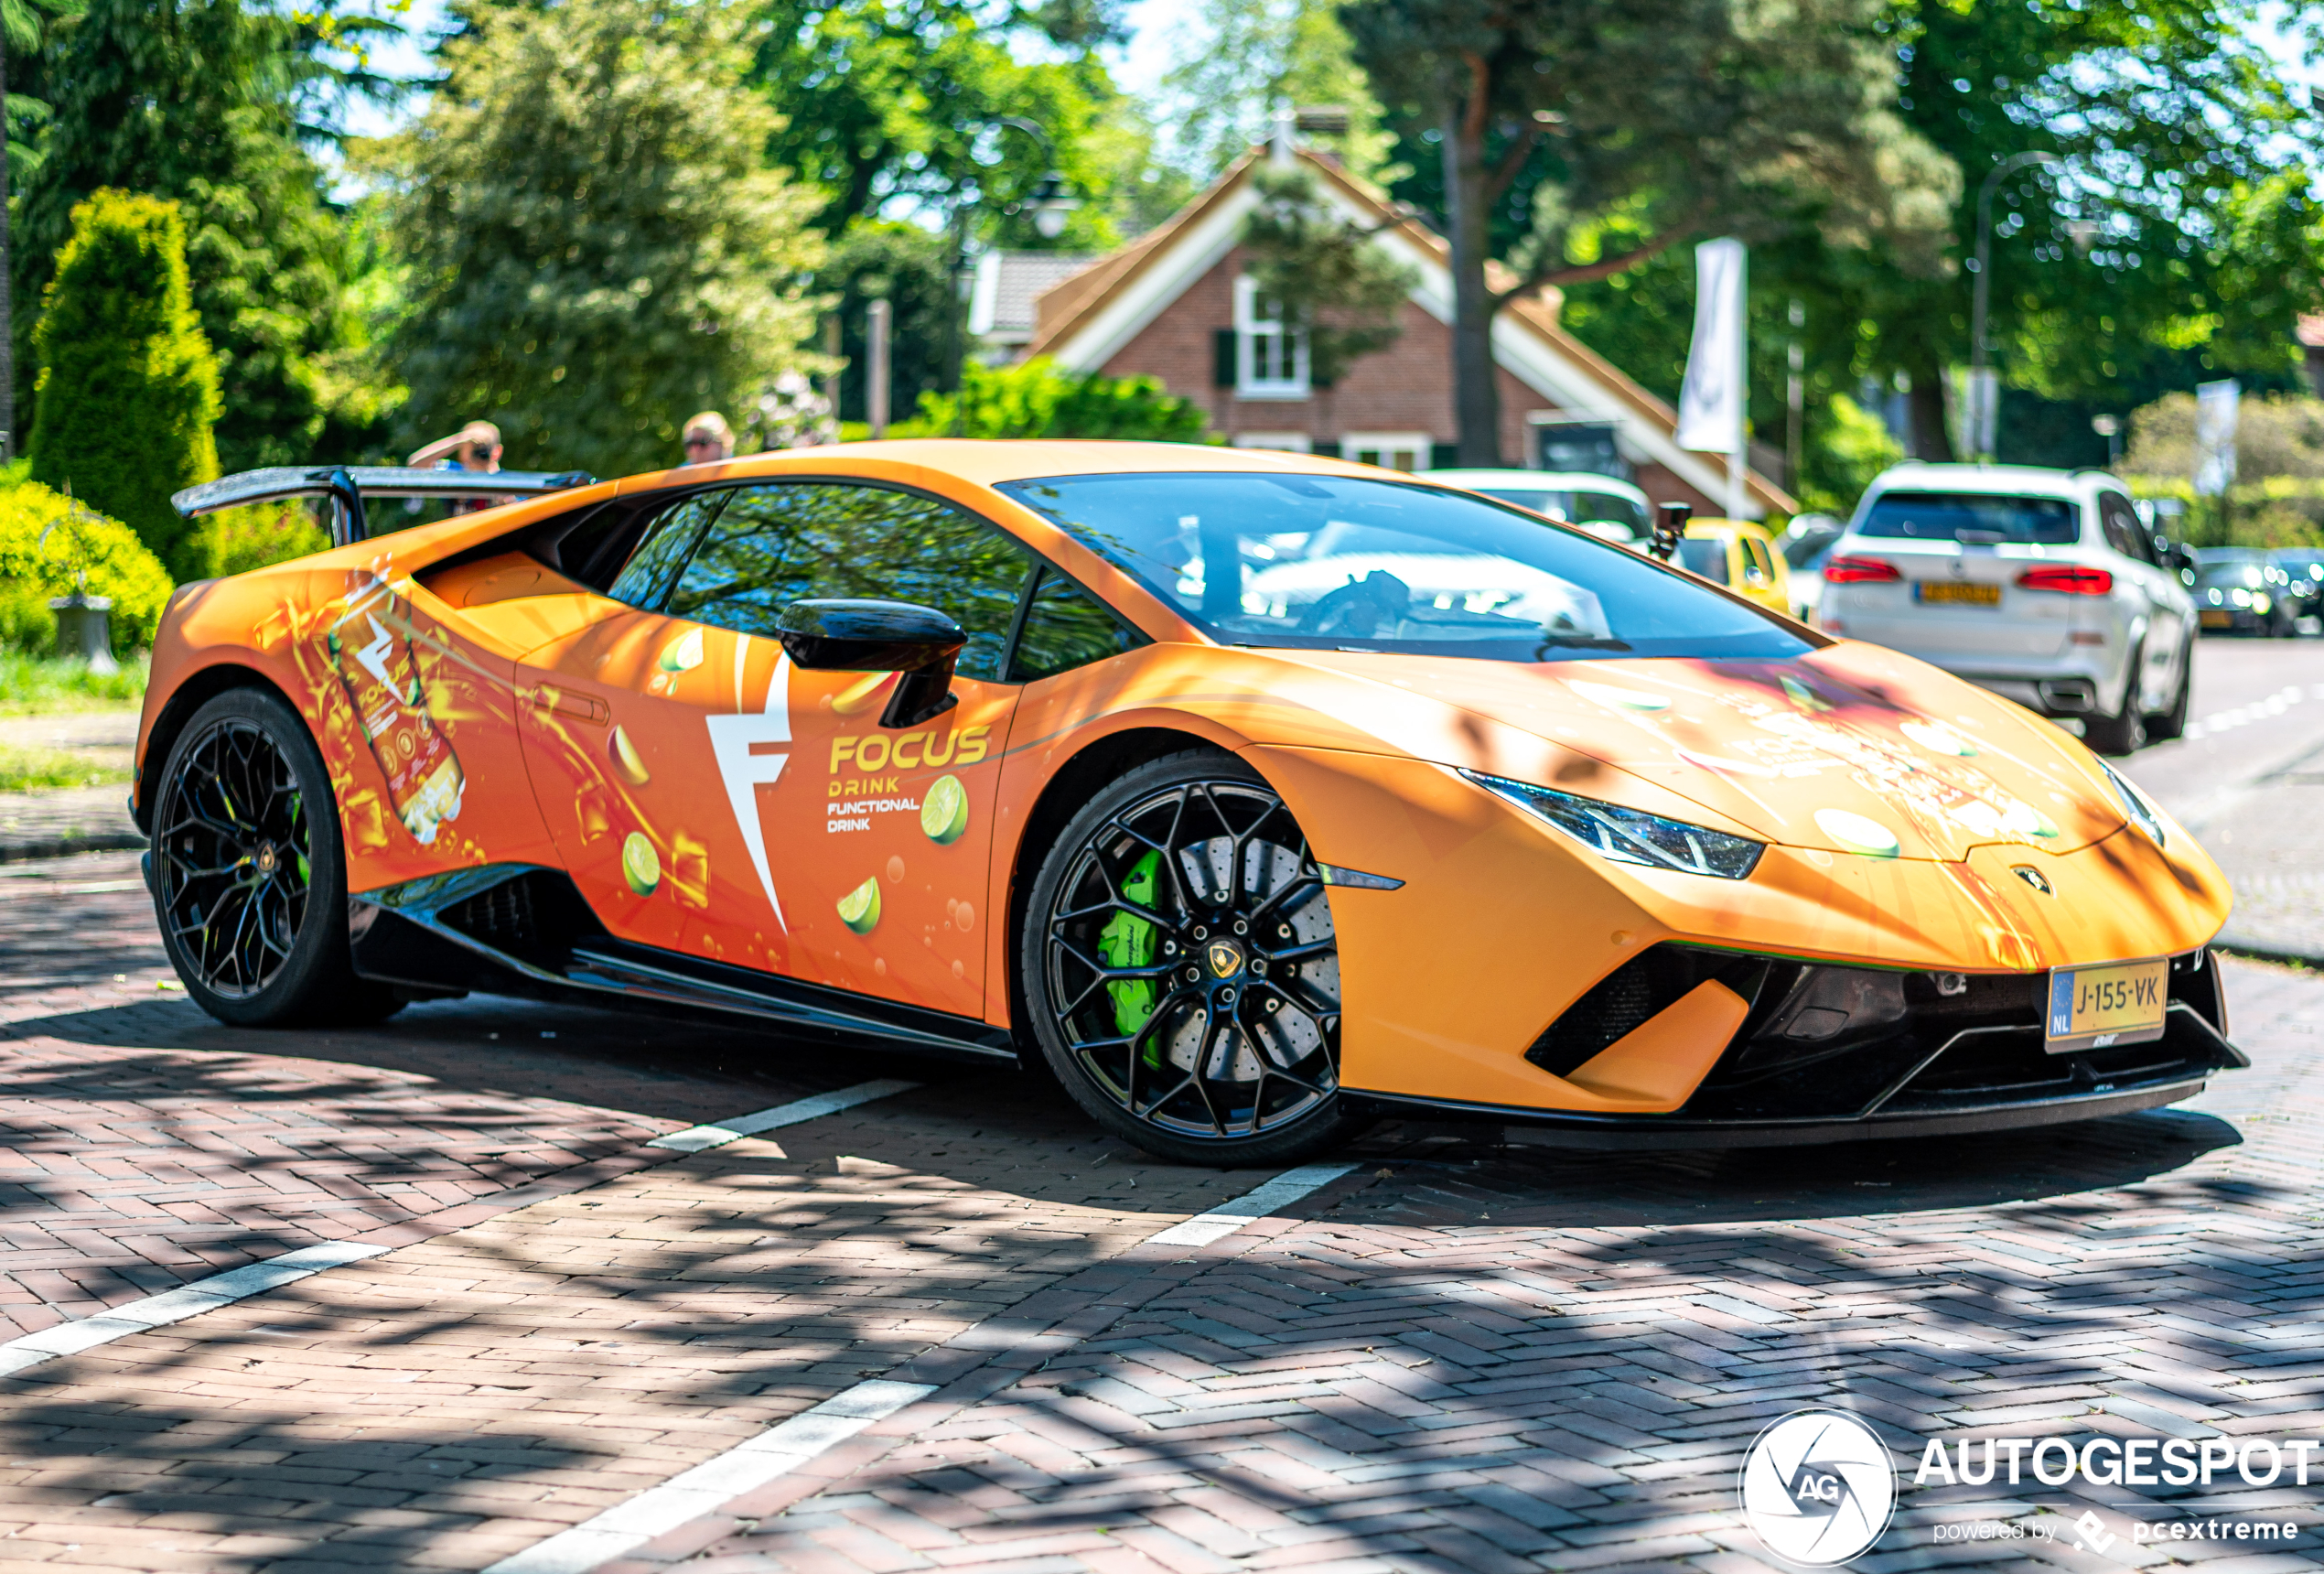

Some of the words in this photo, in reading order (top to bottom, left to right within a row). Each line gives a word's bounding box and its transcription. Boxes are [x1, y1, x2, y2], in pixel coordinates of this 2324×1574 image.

[358, 649, 412, 710] FOCUS
[830, 726, 991, 774] FOCUS
[828, 776, 899, 797] DRINK
[827, 798, 920, 815] FUNCTIONAL
[827, 818, 871, 833] DRINK
[2076, 976, 2157, 1014] J-155-VK
[2053, 1014, 2069, 1033] NL
